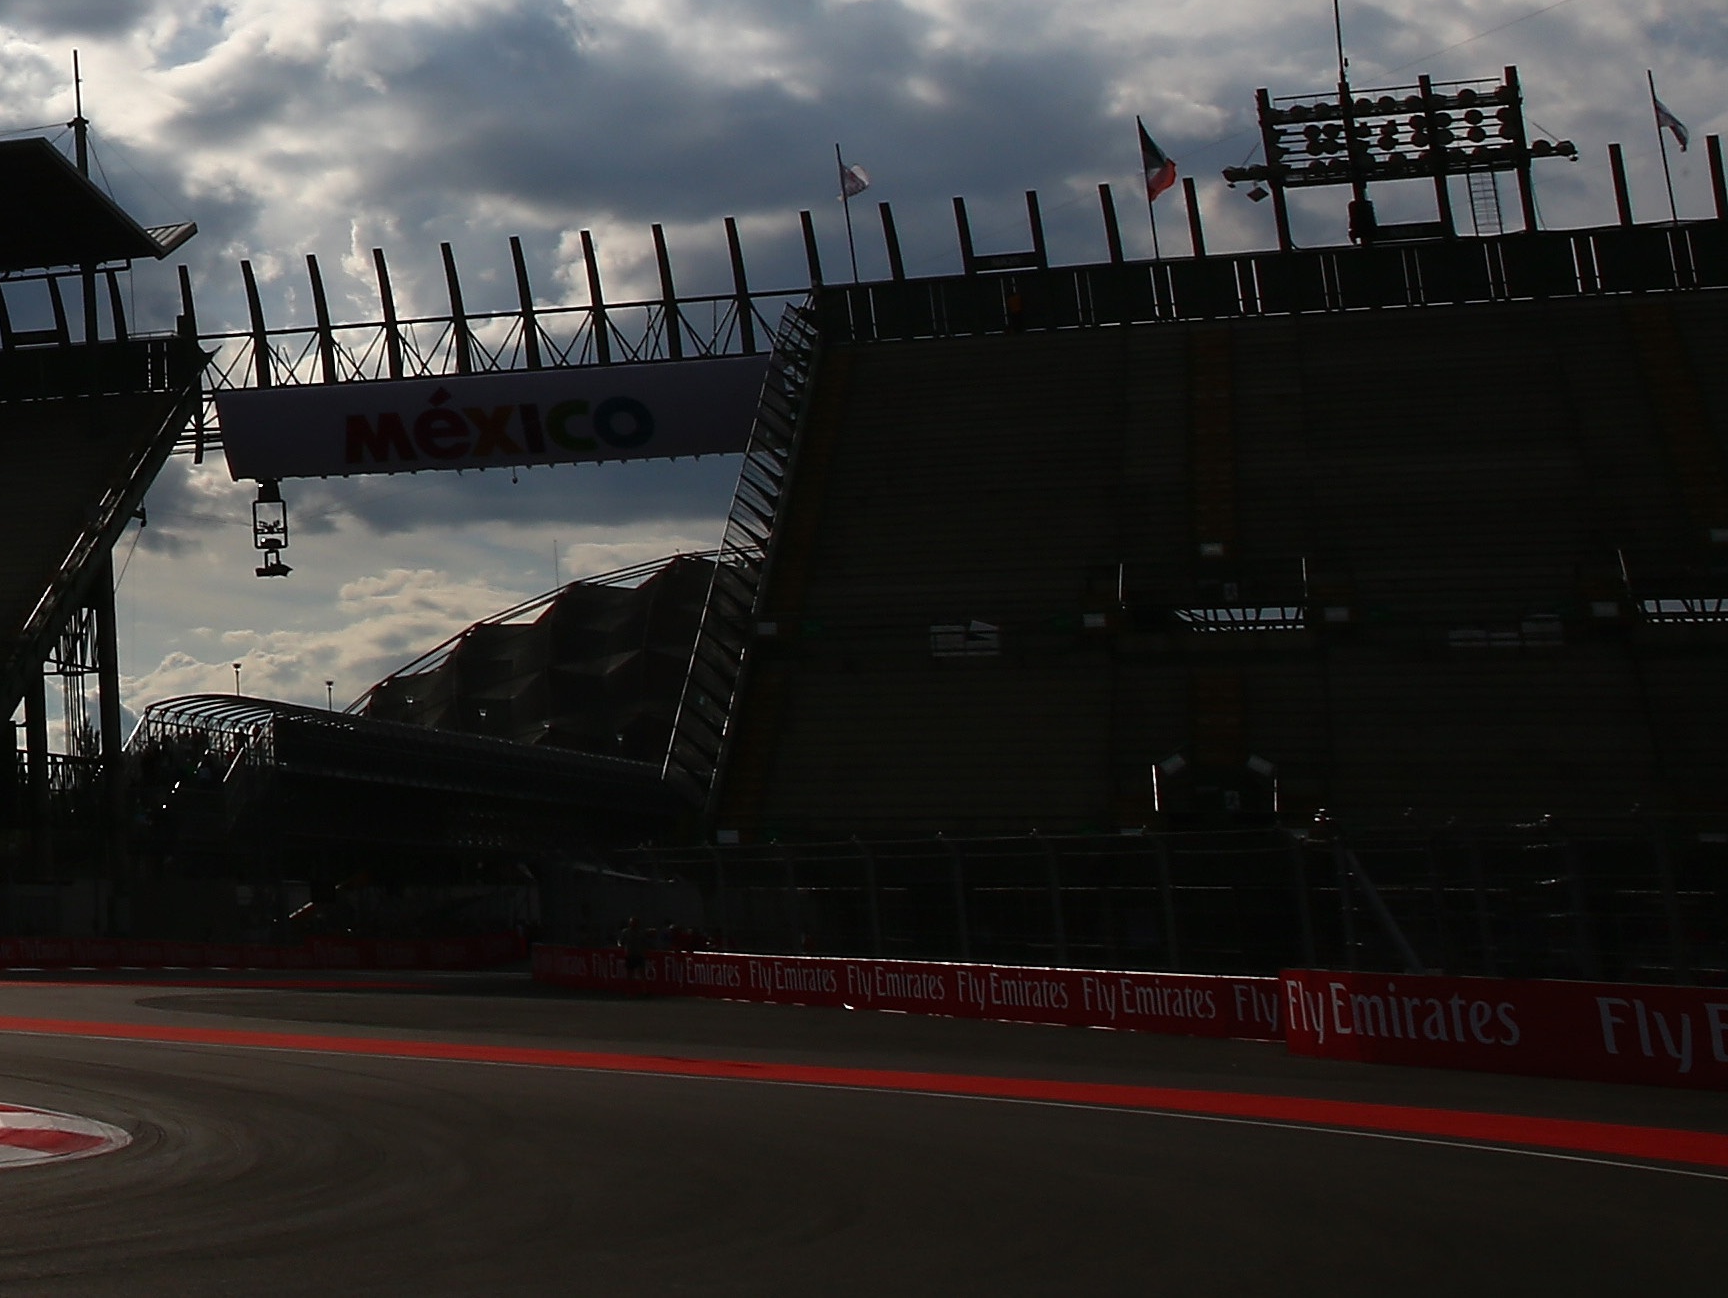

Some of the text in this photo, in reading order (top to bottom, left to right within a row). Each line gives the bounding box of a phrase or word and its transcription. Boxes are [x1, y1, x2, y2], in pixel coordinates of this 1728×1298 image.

[664, 956, 740, 988] Fly Emirates
[749, 960, 837, 995] Fly Emirates
[846, 964, 944, 1002] Fly Emirates
[956, 970, 1069, 1011] Fly Emirates
[1082, 976, 1216, 1020] Fly Emirates
[1232, 984, 1278, 1032] Fly
[1286, 980, 1520, 1046] Fly Emirates
[1595, 997, 1690, 1073] Fly
